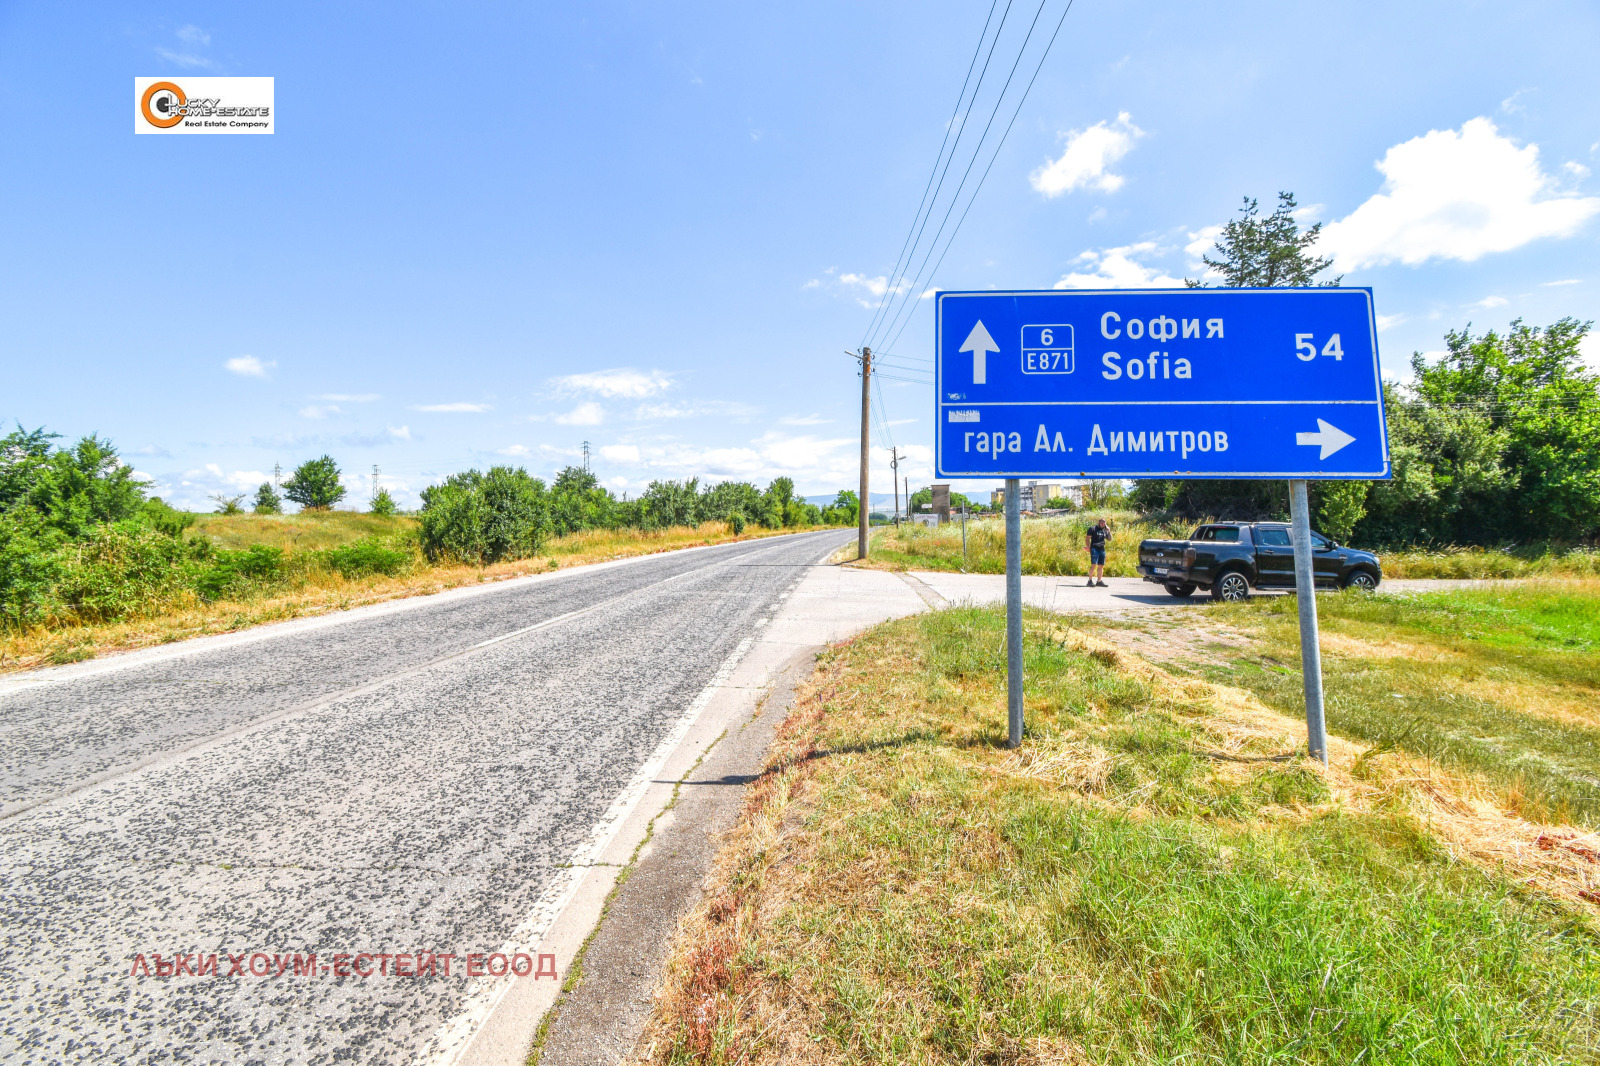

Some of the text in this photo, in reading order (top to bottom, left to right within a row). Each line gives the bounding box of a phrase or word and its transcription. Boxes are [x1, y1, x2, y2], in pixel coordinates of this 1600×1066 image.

[1040, 328, 1054, 346] 6
[1100, 311, 1224, 342] София
[1027, 352, 1069, 370] E871
[1295, 333, 1345, 362] 54
[1101, 351, 1192, 381] Sofia
[964, 423, 1229, 460] гара Ал. Димитров
